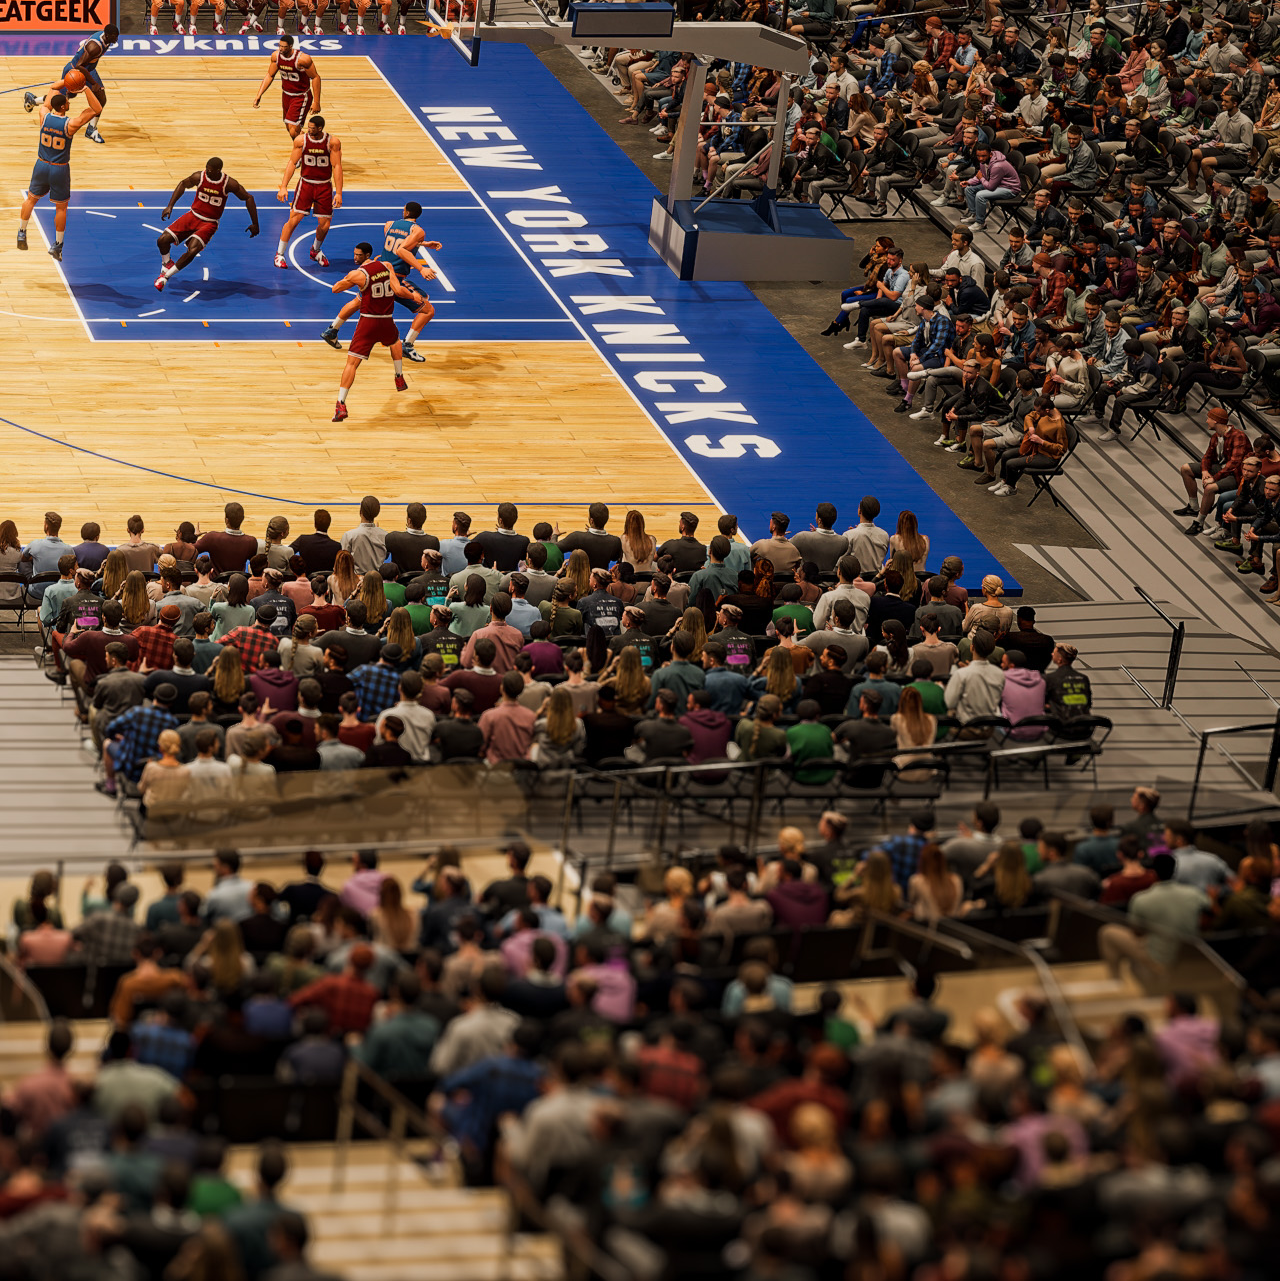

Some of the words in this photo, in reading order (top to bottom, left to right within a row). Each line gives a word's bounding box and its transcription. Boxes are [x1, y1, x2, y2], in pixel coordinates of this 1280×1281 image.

[41, 132, 67, 150] 00
[304, 154, 329, 167] 00
[198, 191, 223, 207] 00
[371, 280, 394, 298] 00
[420, 107, 543, 171] NEW
[487, 186, 634, 278] YORK
[570, 296, 782, 458] KNICKS
